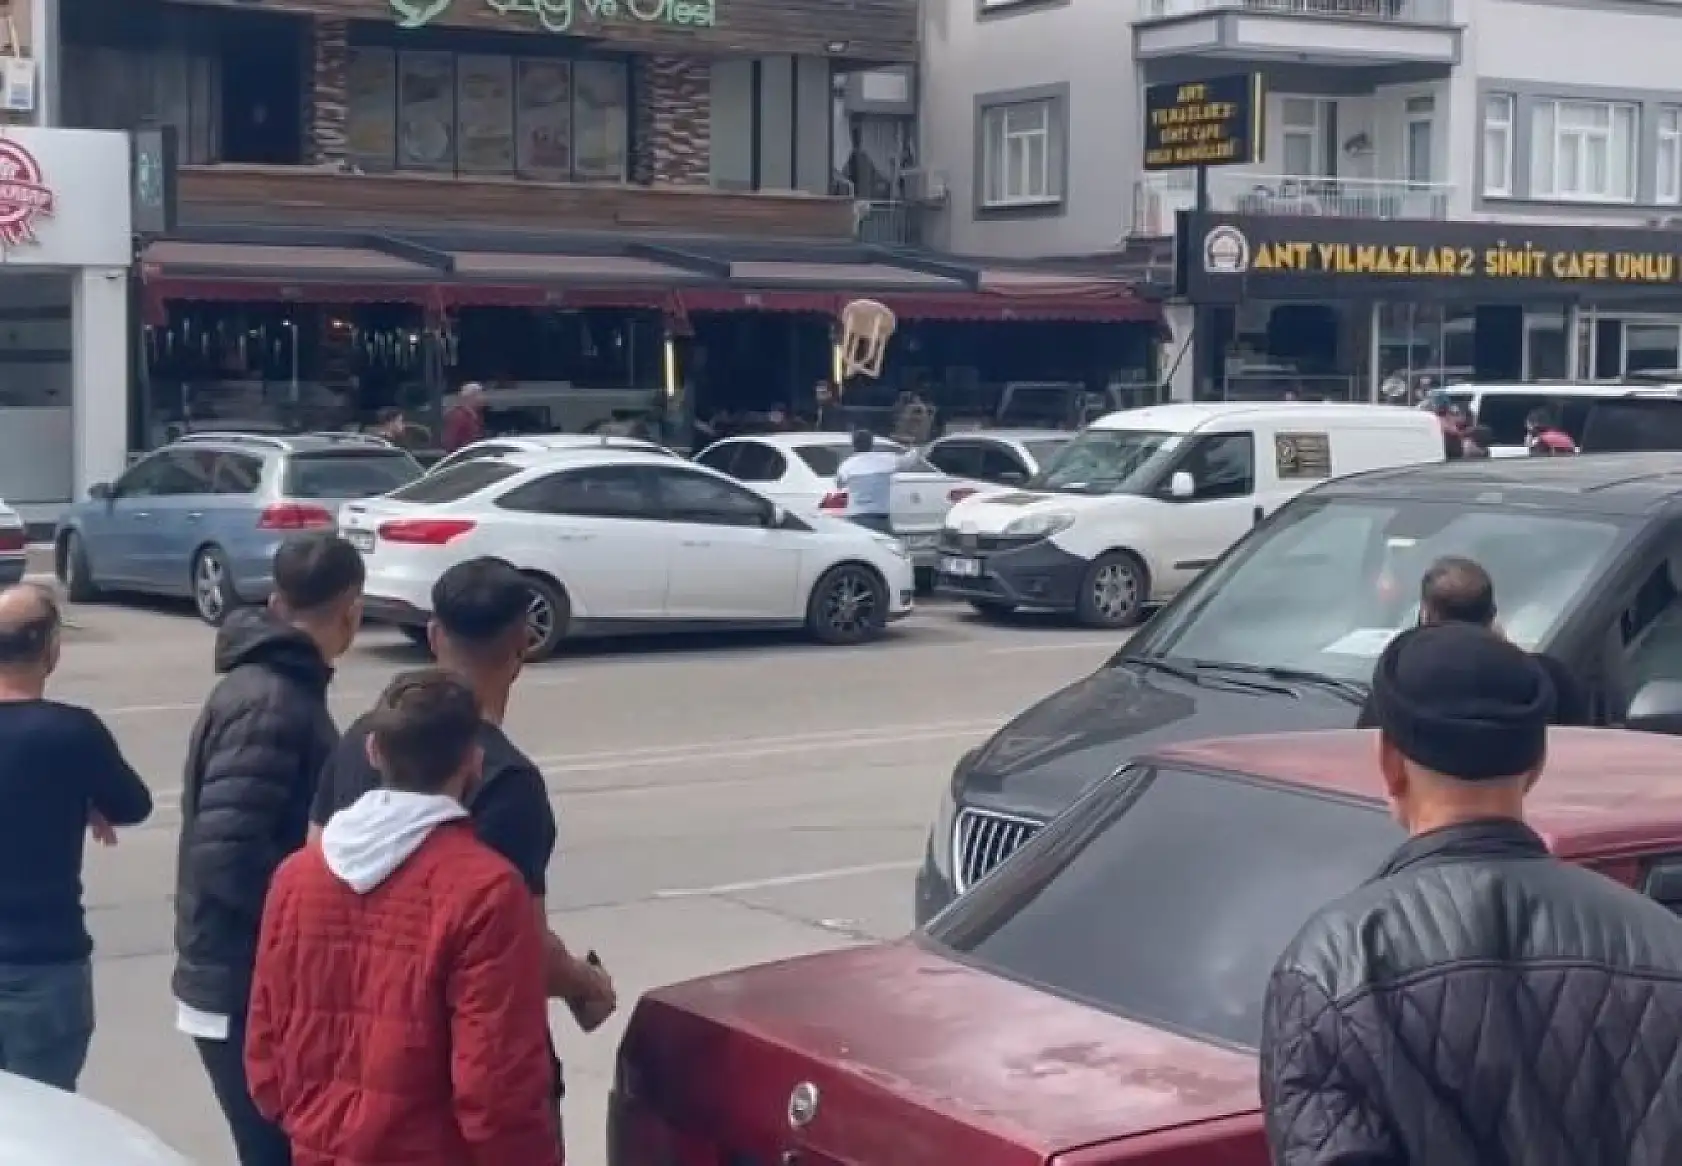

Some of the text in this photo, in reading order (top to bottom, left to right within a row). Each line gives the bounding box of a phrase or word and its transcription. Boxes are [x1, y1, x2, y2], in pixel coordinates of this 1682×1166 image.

[1253, 241, 1312, 269] ANT
[1319, 242, 1457, 276] YILMAZLAR
[1486, 238, 1546, 278] SİMİT
[1552, 252, 1609, 279] CAFE
[1616, 252, 1673, 281] UNLU
